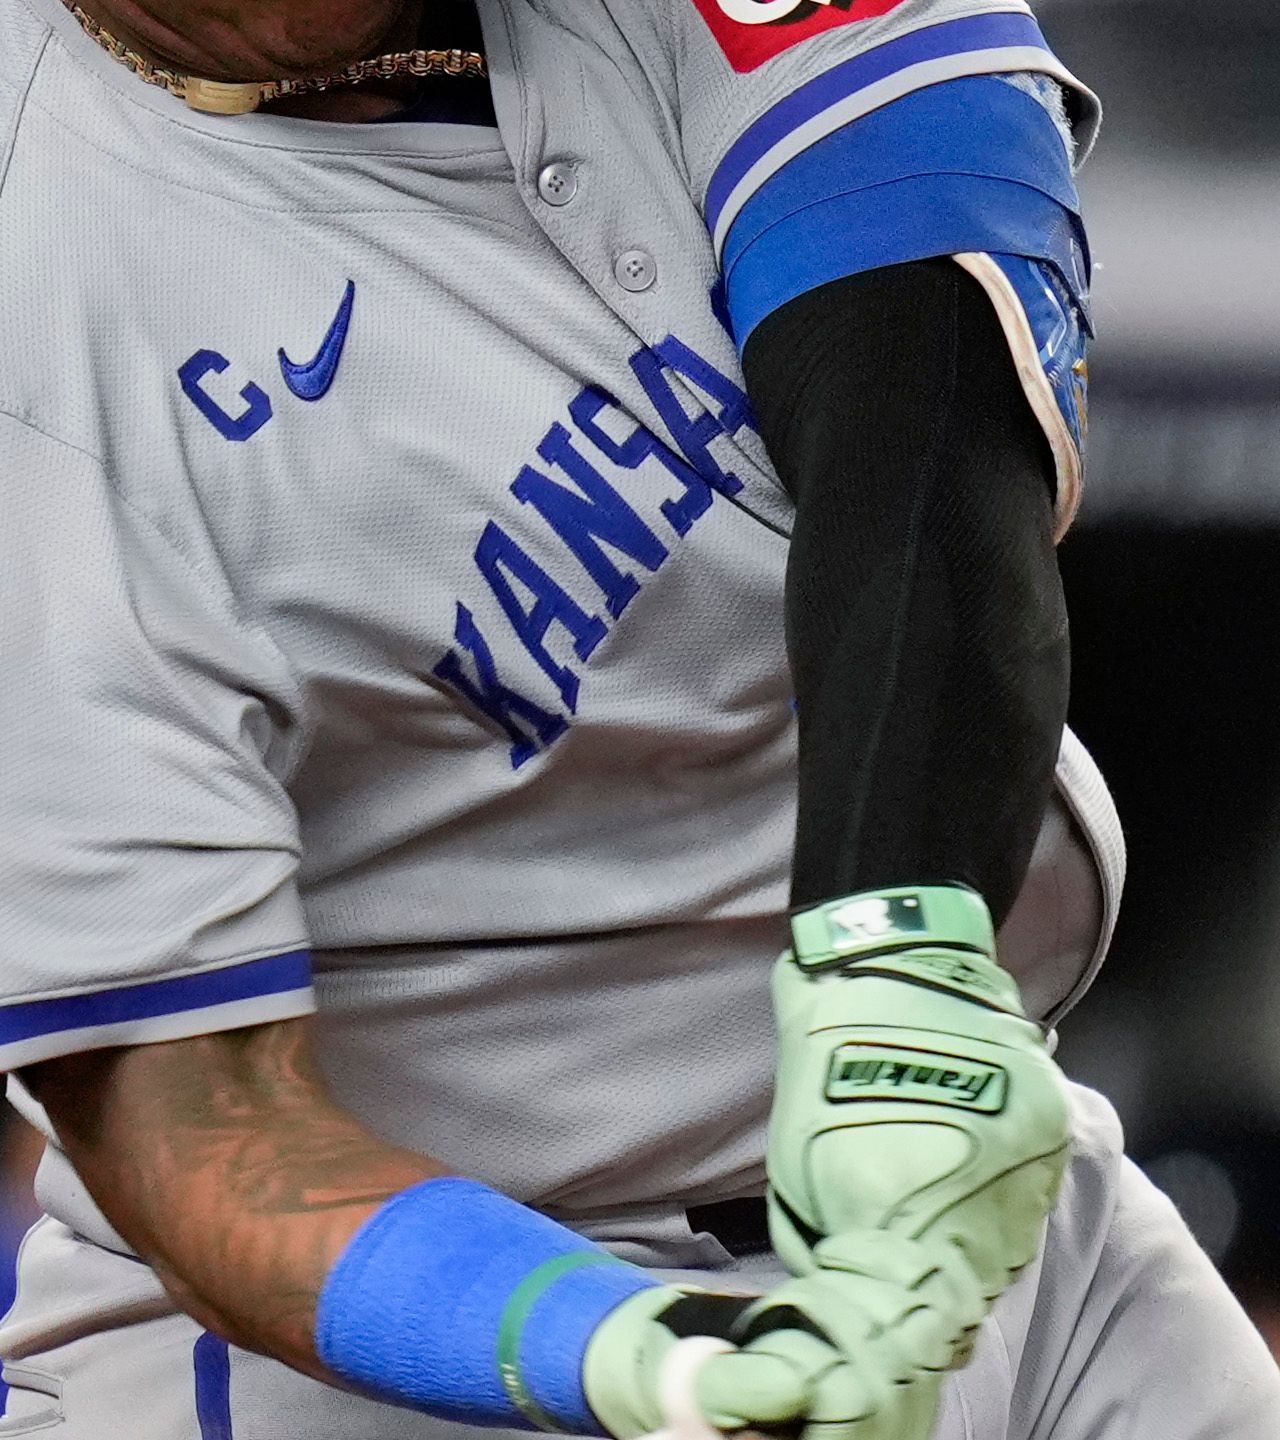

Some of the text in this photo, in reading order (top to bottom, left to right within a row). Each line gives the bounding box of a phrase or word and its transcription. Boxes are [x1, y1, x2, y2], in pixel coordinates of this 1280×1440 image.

[176, 347, 272, 442] C
[432, 278, 763, 770] KANSA
[834, 1060, 995, 1103] Franklin
